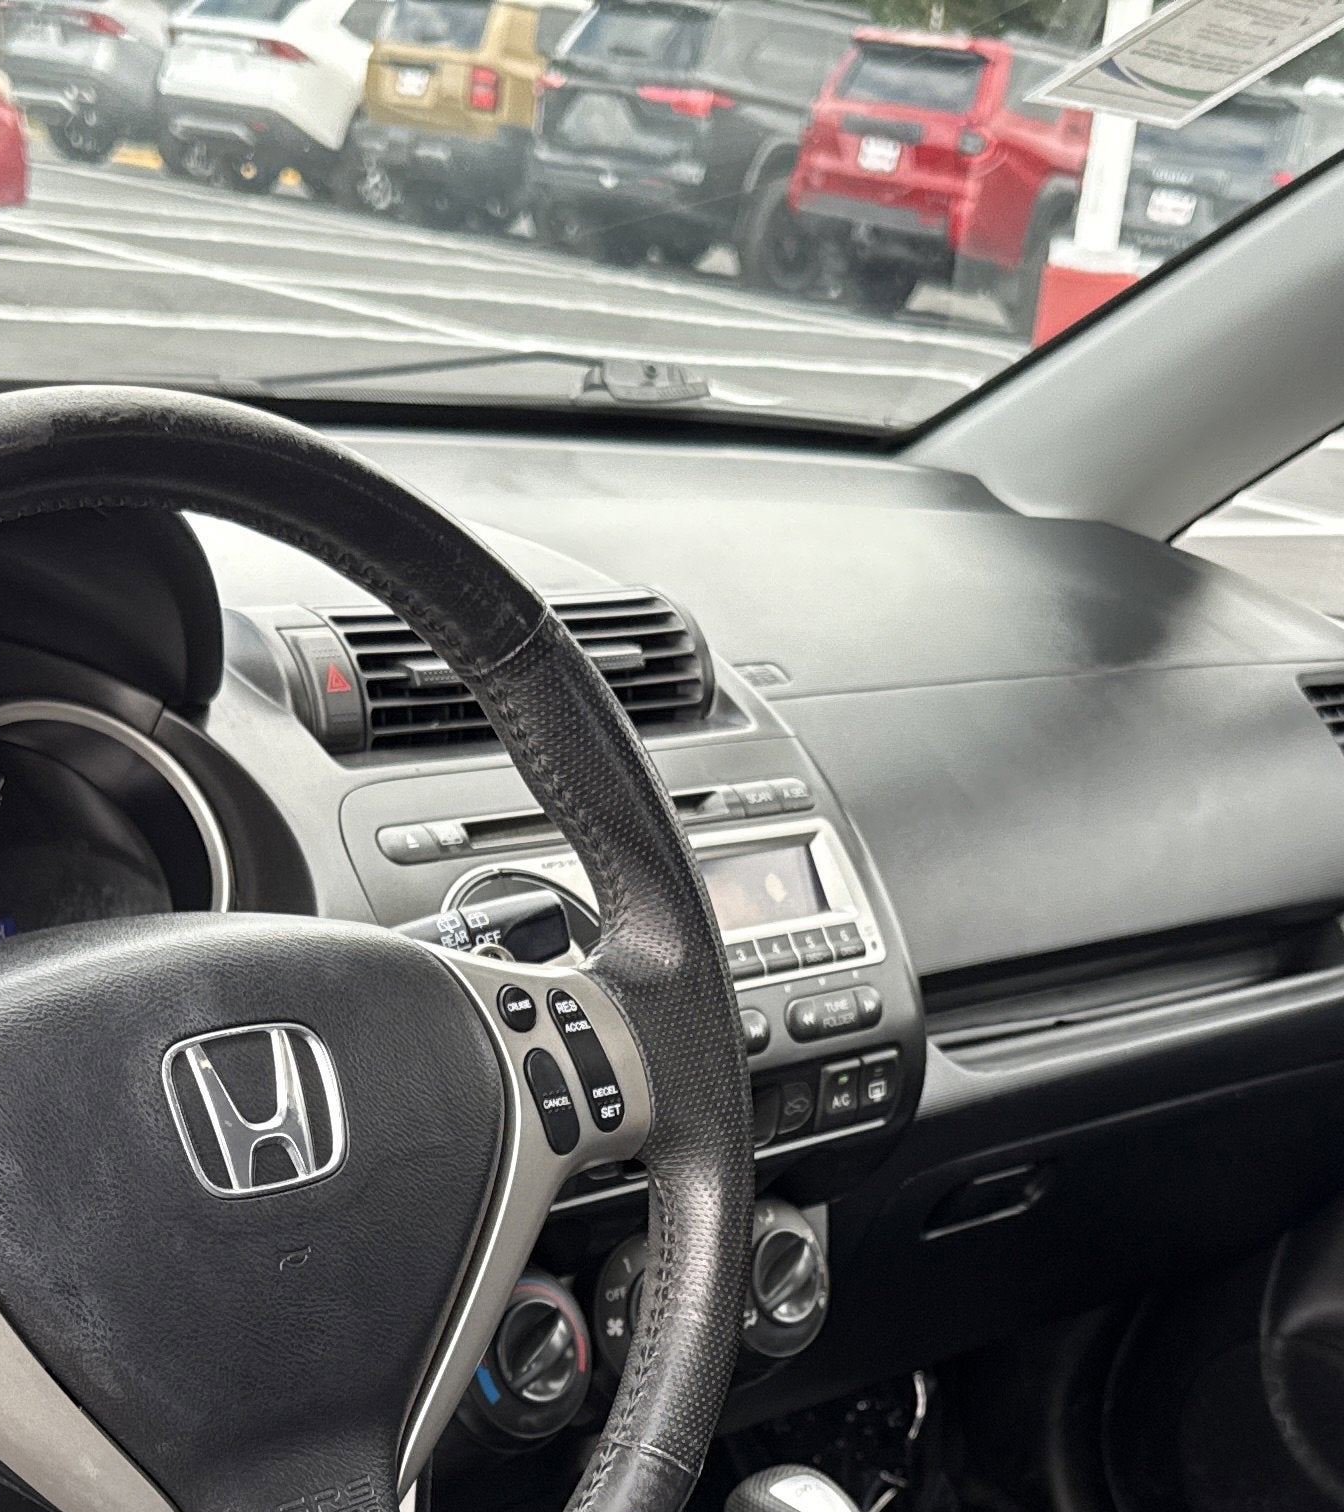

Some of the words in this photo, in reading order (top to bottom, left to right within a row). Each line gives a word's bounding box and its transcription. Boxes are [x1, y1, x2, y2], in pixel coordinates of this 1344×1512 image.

[475, 929, 503, 946] OFF
[507, 1000, 532, 1012] CRUISE
[556, 1000, 577, 1014] RES
[565, 1021, 591, 1033] ACCEL
[593, 1085, 618, 1099] DECEL
[543, 1096, 571, 1109] CANCEL
[601, 1103, 622, 1119] SET
